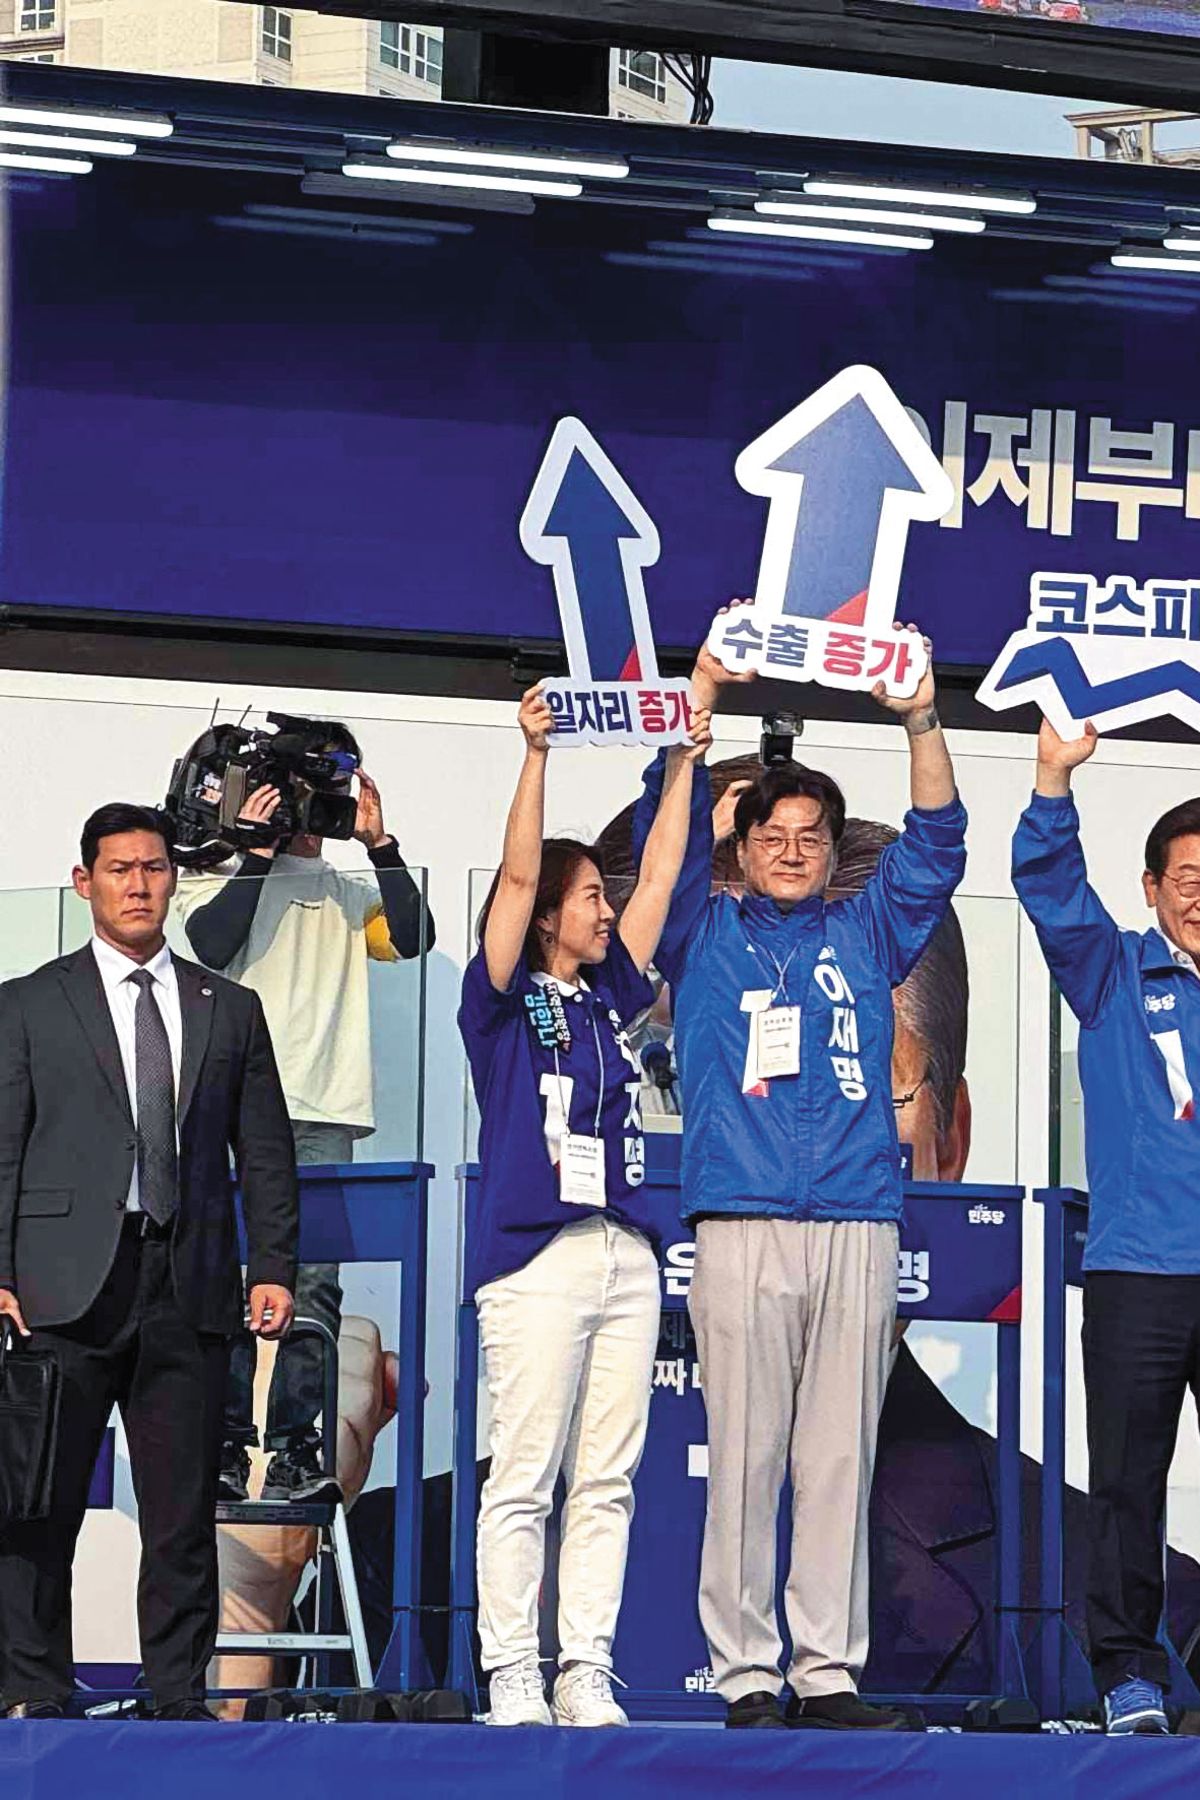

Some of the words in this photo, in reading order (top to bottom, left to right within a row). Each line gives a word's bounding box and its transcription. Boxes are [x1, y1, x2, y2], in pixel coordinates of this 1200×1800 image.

[722, 618, 810, 668] 수출
[823, 631, 912, 684] 증가
[546, 690, 633, 734] 일자리
[637, 690, 693, 733] 증가
[814, 964, 868, 1101] 이재명
[1149, 1029, 1195, 1121] 1
